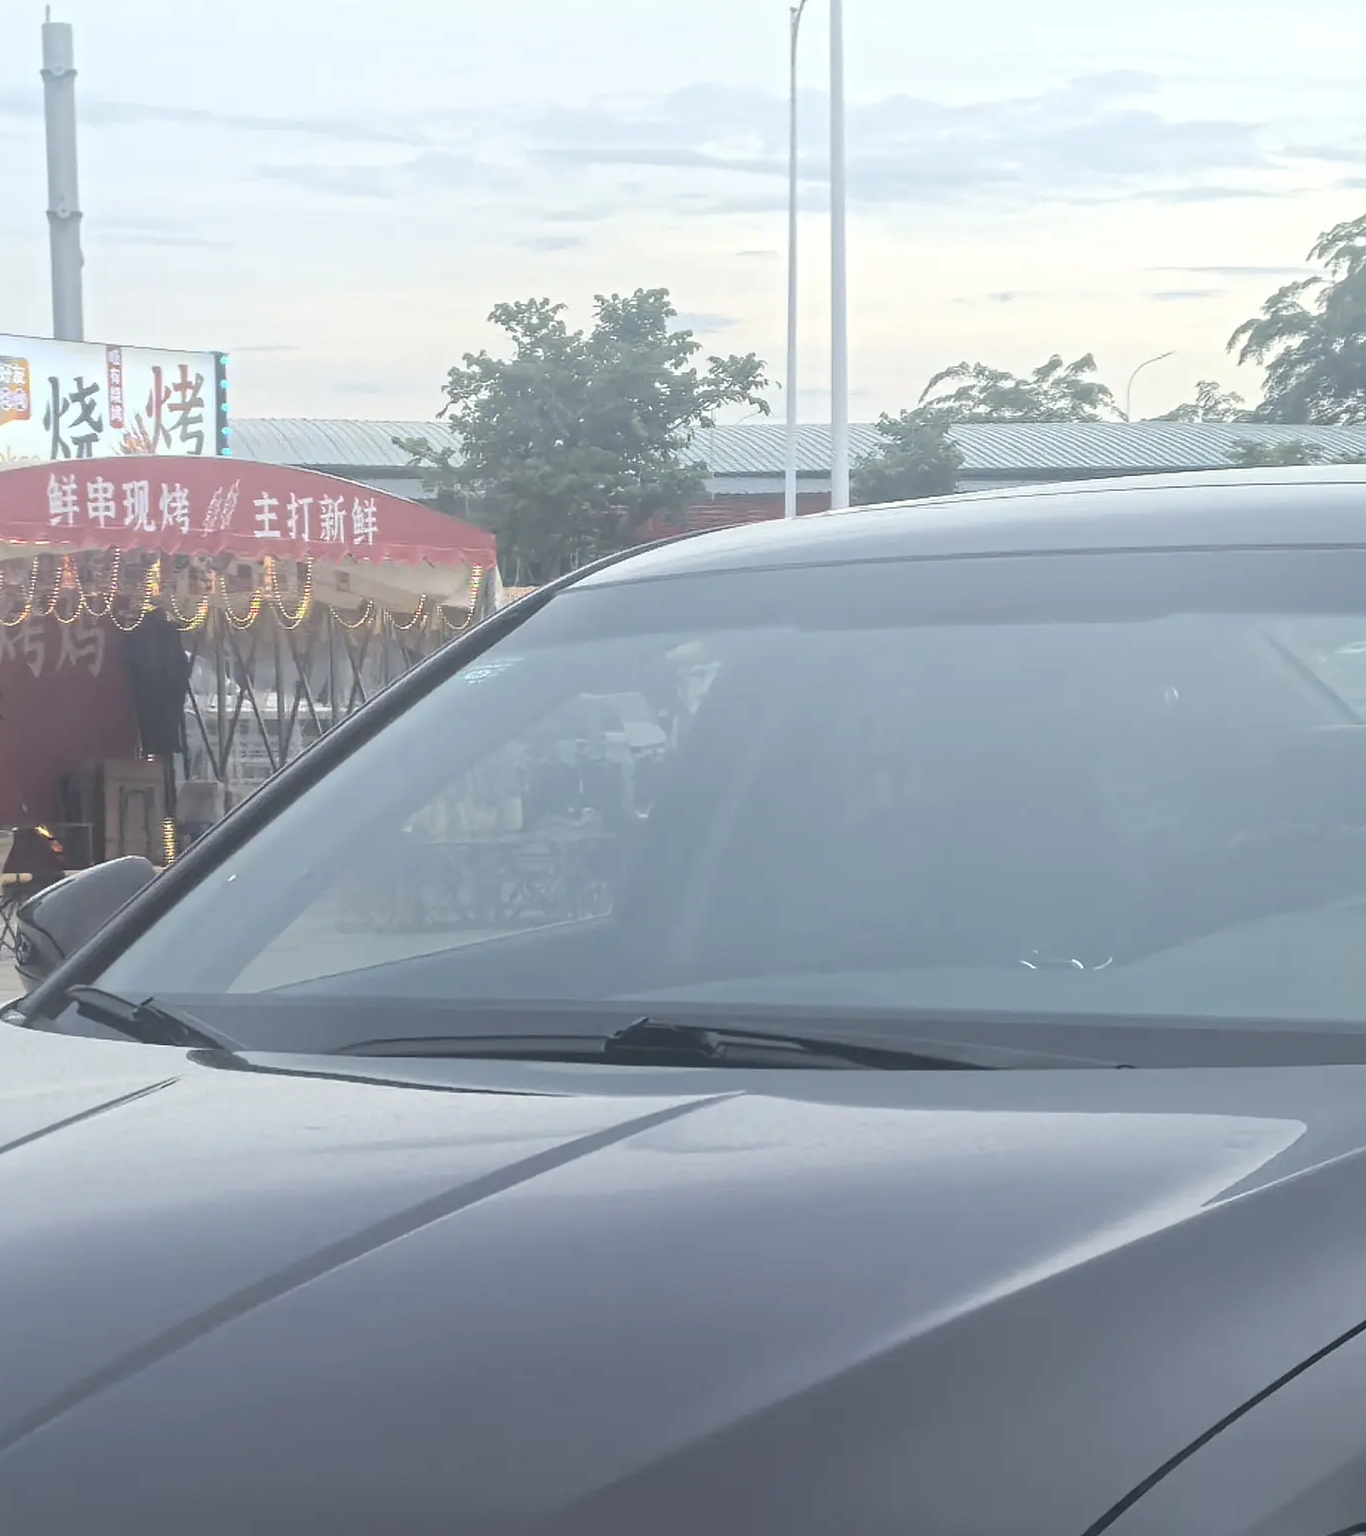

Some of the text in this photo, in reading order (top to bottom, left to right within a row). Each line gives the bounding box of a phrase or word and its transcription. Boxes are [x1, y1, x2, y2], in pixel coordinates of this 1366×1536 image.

[47, 473, 379, 545] 鲜串现烤 主打新鲜
